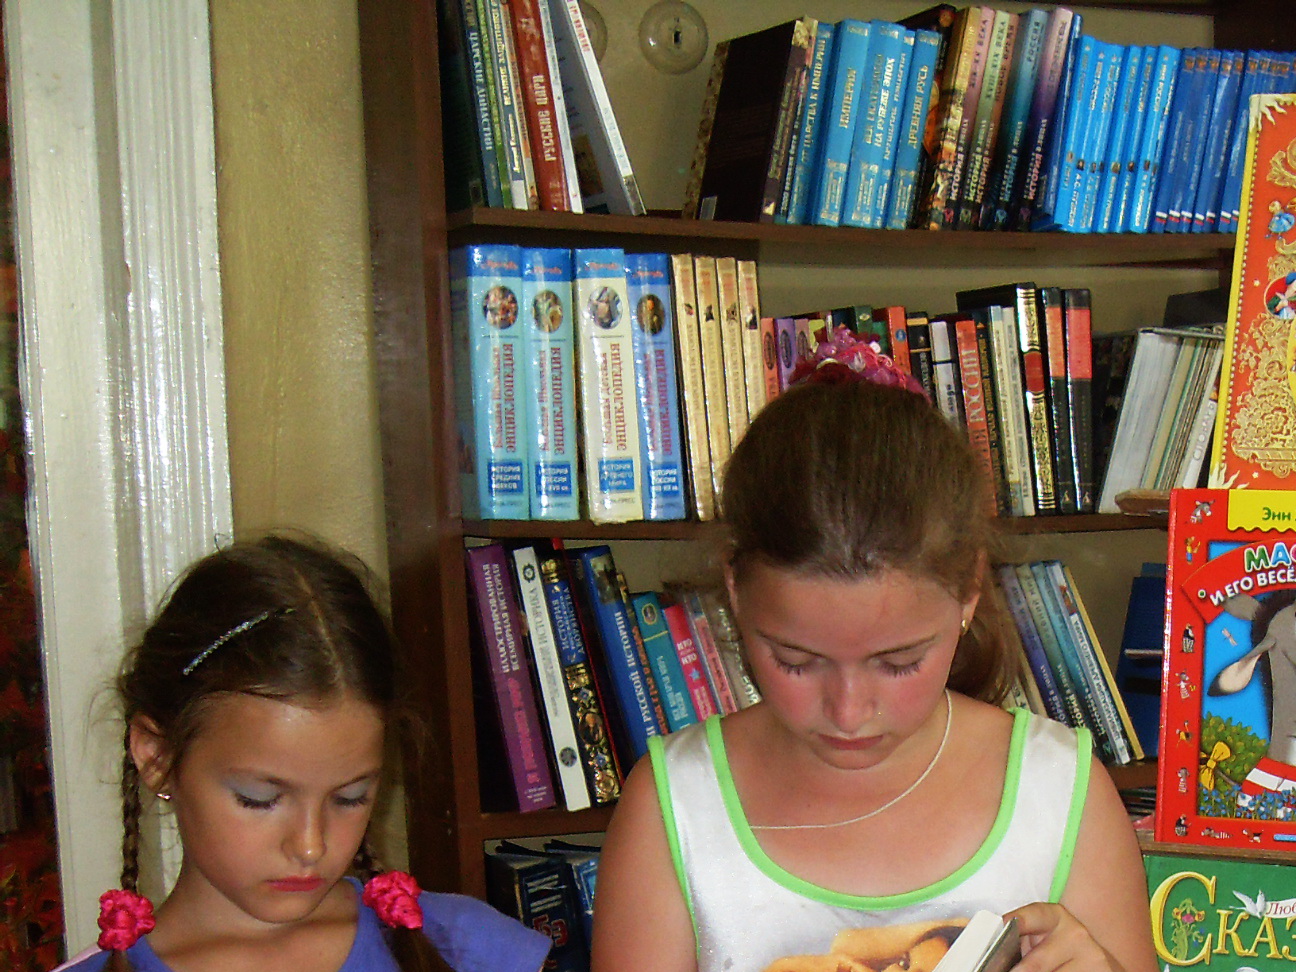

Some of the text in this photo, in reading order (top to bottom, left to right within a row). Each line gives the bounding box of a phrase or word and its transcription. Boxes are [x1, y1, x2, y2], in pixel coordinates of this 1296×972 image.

[838, 68, 856, 128] ИМПЕРИЯ
[884, 57, 895, 88] ЭПОХ
[532, 74, 557, 162] РУССКИЕ ЦАРИ
[908, 65, 929, 149] ДРЕВНЯЯ РУСЬ
[502, 343, 516, 454] ЭНЦИКЛОПЕДИЯ
[551, 346, 565, 455] ЭНЦИКЛОПЕДИЯ
[610, 342, 627, 451] ЭНЦИКЛОПЕДИЯ
[960, 347, 984, 424] РОССИИ
[1262, 507, 1291, 522] Энн
[1210, 590, 1225, 606] И
[1225, 576, 1254, 599] ЕГО
[613, 610, 635, 667] ИСТОРИИ
[628, 670, 653, 723] РУССКОЙ
